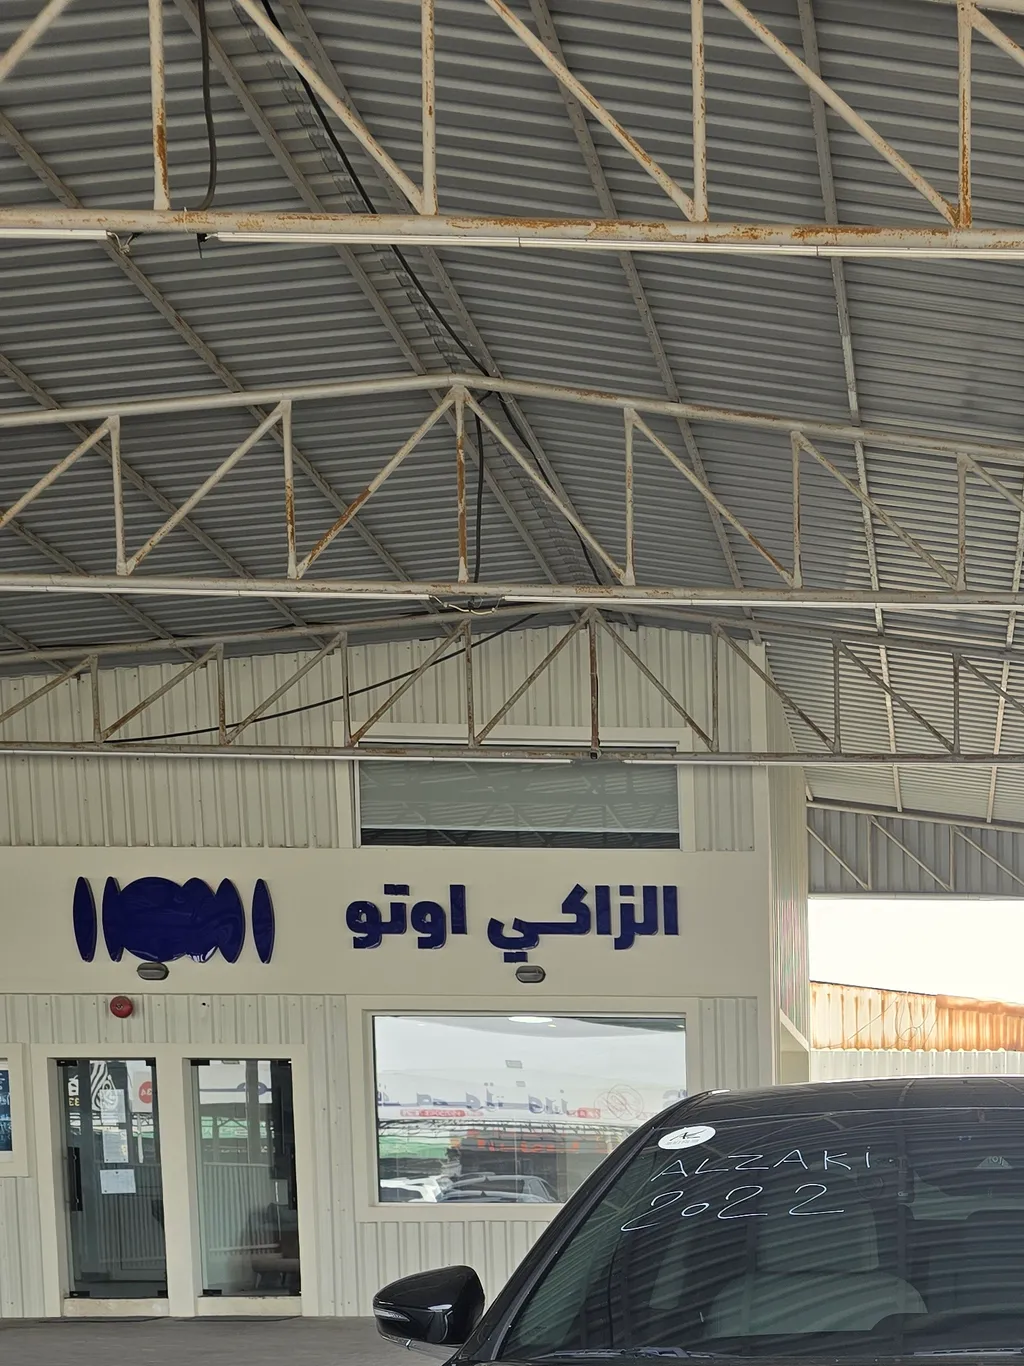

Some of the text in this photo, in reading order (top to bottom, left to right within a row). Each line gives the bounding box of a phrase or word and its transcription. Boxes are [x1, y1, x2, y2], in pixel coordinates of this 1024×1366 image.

[346, 883, 679, 963] الزاكي اوتو
[621, 1183, 844, 1231] 2022
